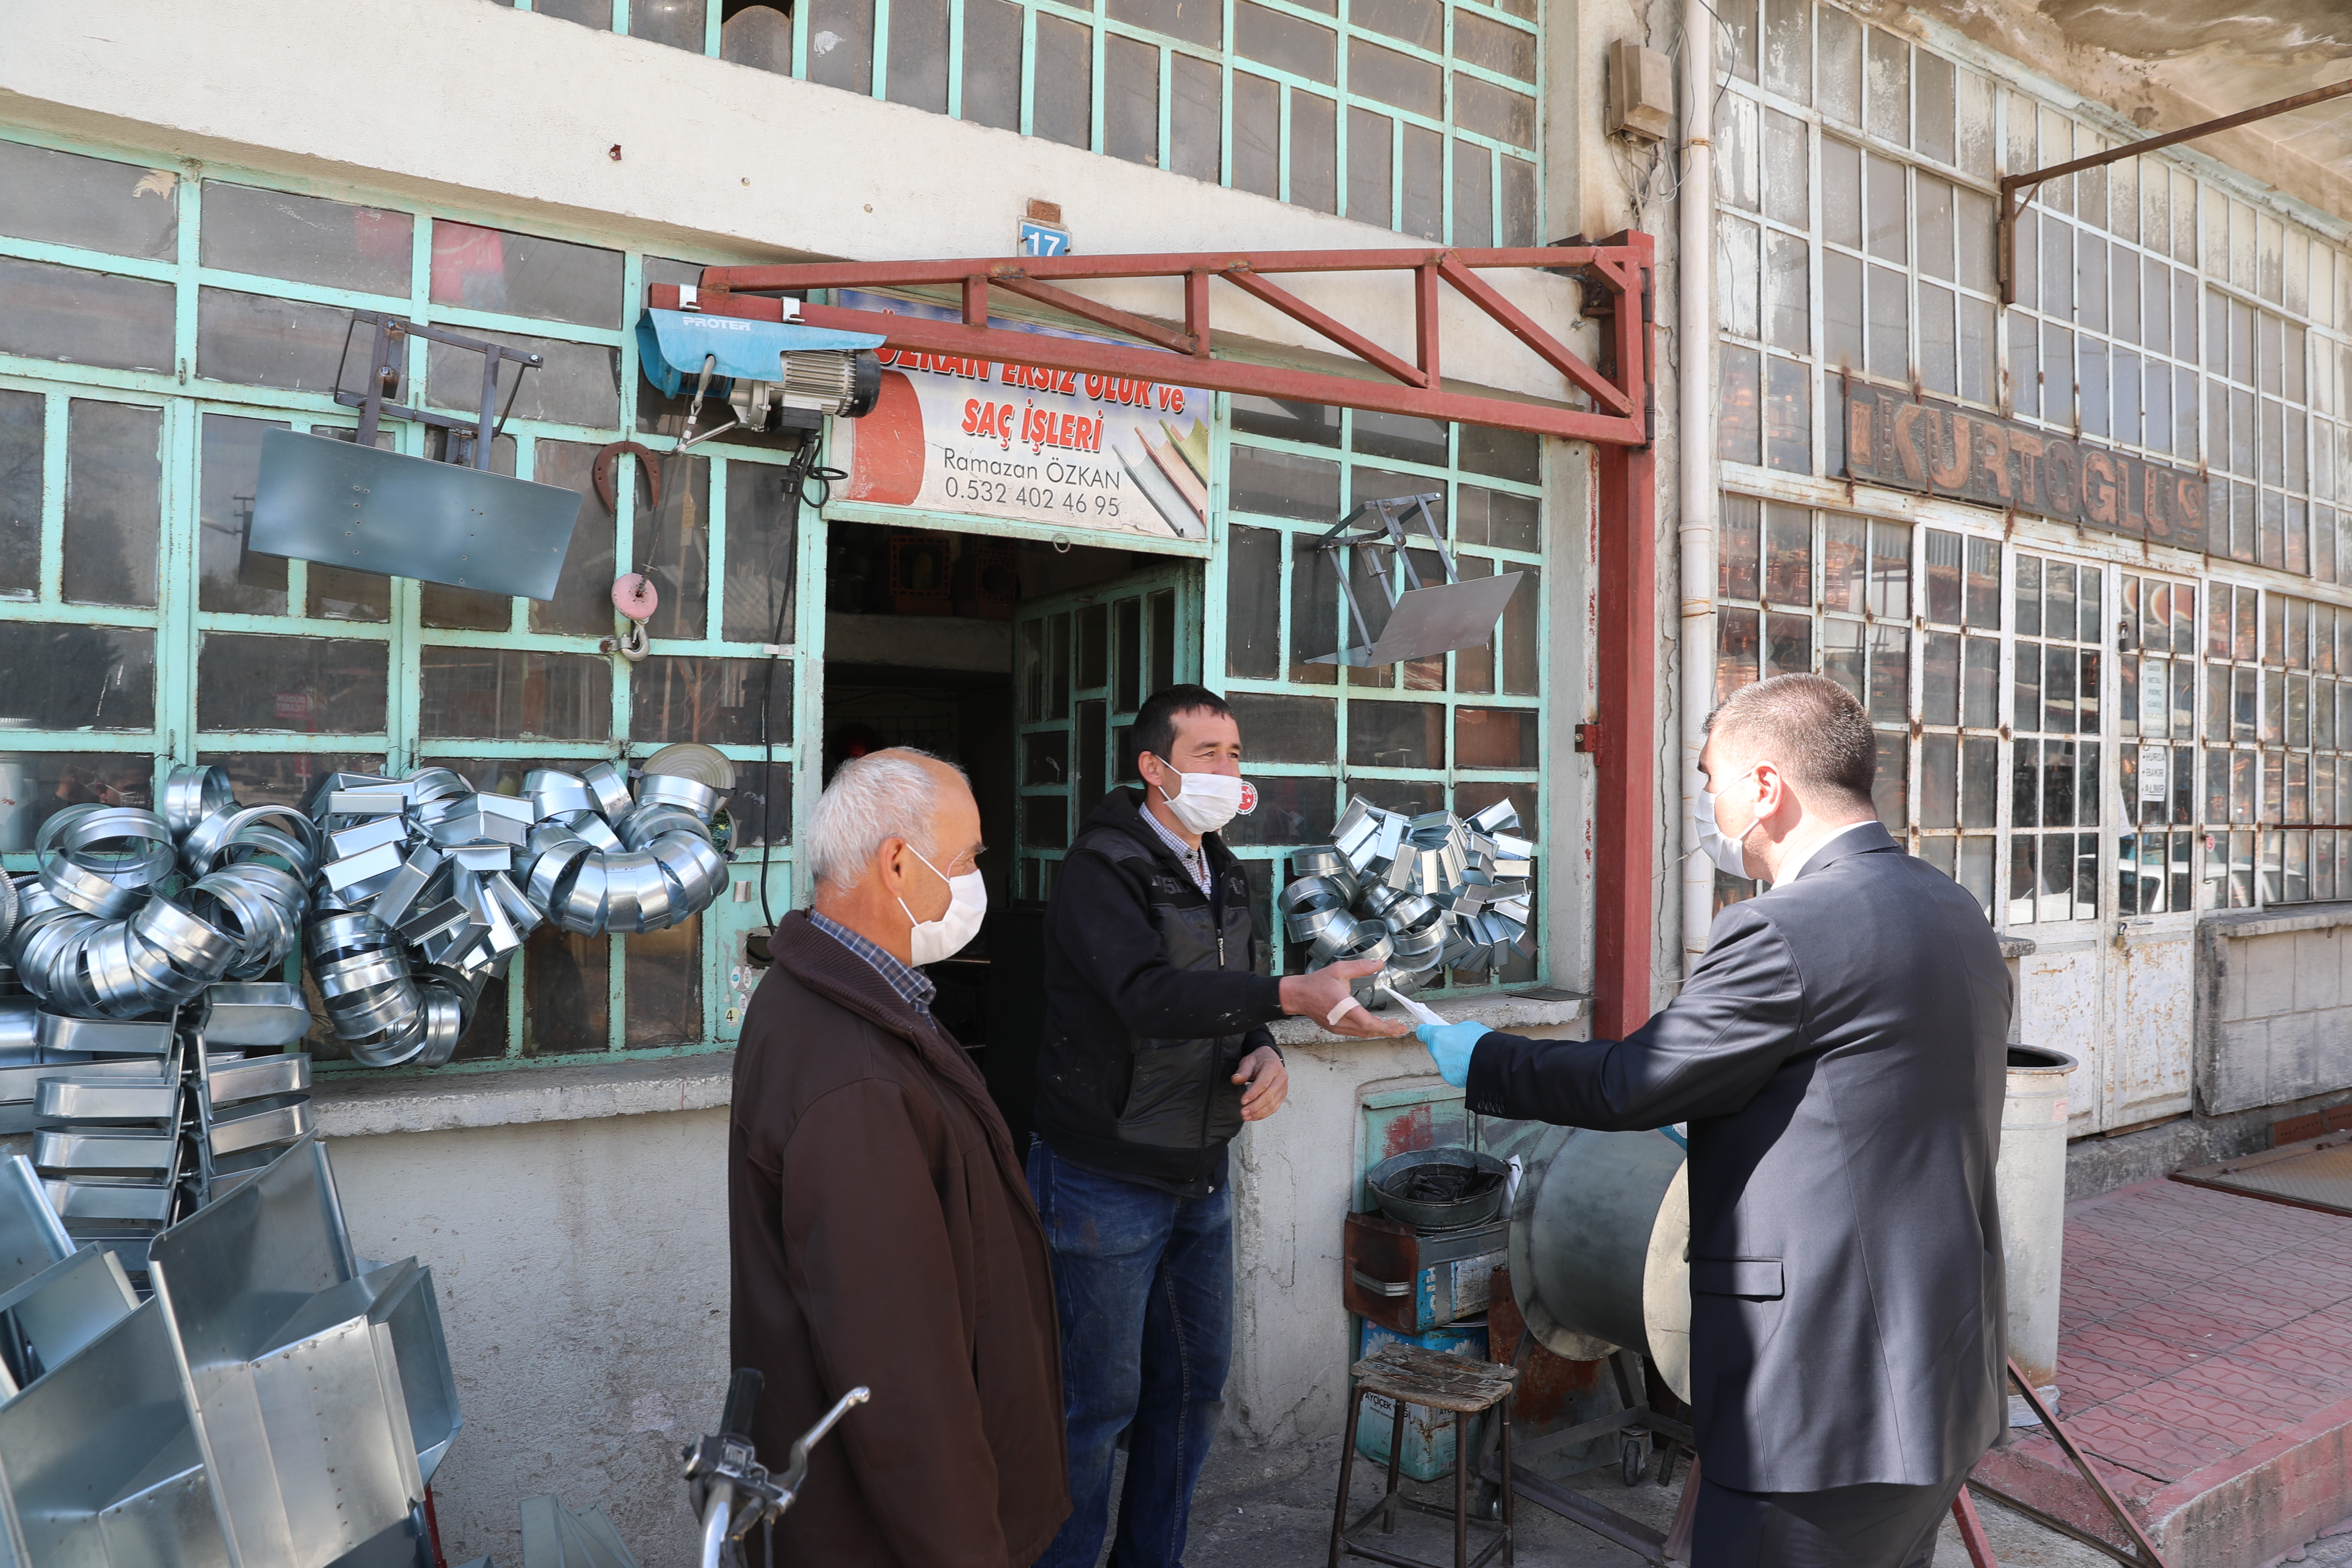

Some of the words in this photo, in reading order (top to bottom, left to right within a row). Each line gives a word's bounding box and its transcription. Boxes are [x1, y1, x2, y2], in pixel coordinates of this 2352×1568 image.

[1029, 232, 1060, 256] 17
[682, 316, 751, 331] PROTER
[1084, 373, 1151, 407] OLUK
[1157, 385, 1185, 413] ve
[961, 398, 1014, 449] SAÇ
[1020, 398, 1103, 453] İŞLERİ
[944, 447, 1038, 480] Ramazan
[1046, 457, 1120, 490] ÖZKAN
[946, 477, 1006, 503] 0.532
[1016, 486, 1054, 508] 402
[1063, 492, 1087, 513] 46
[1095, 496, 1118, 517] 95
[2146, 753, 2165, 761] HURDA
[2146, 768, 2164, 777] BAKIR
[726, 1010, 734, 1021] 4
[1365, 1392, 1391, 1411] AYÇİÇEK
